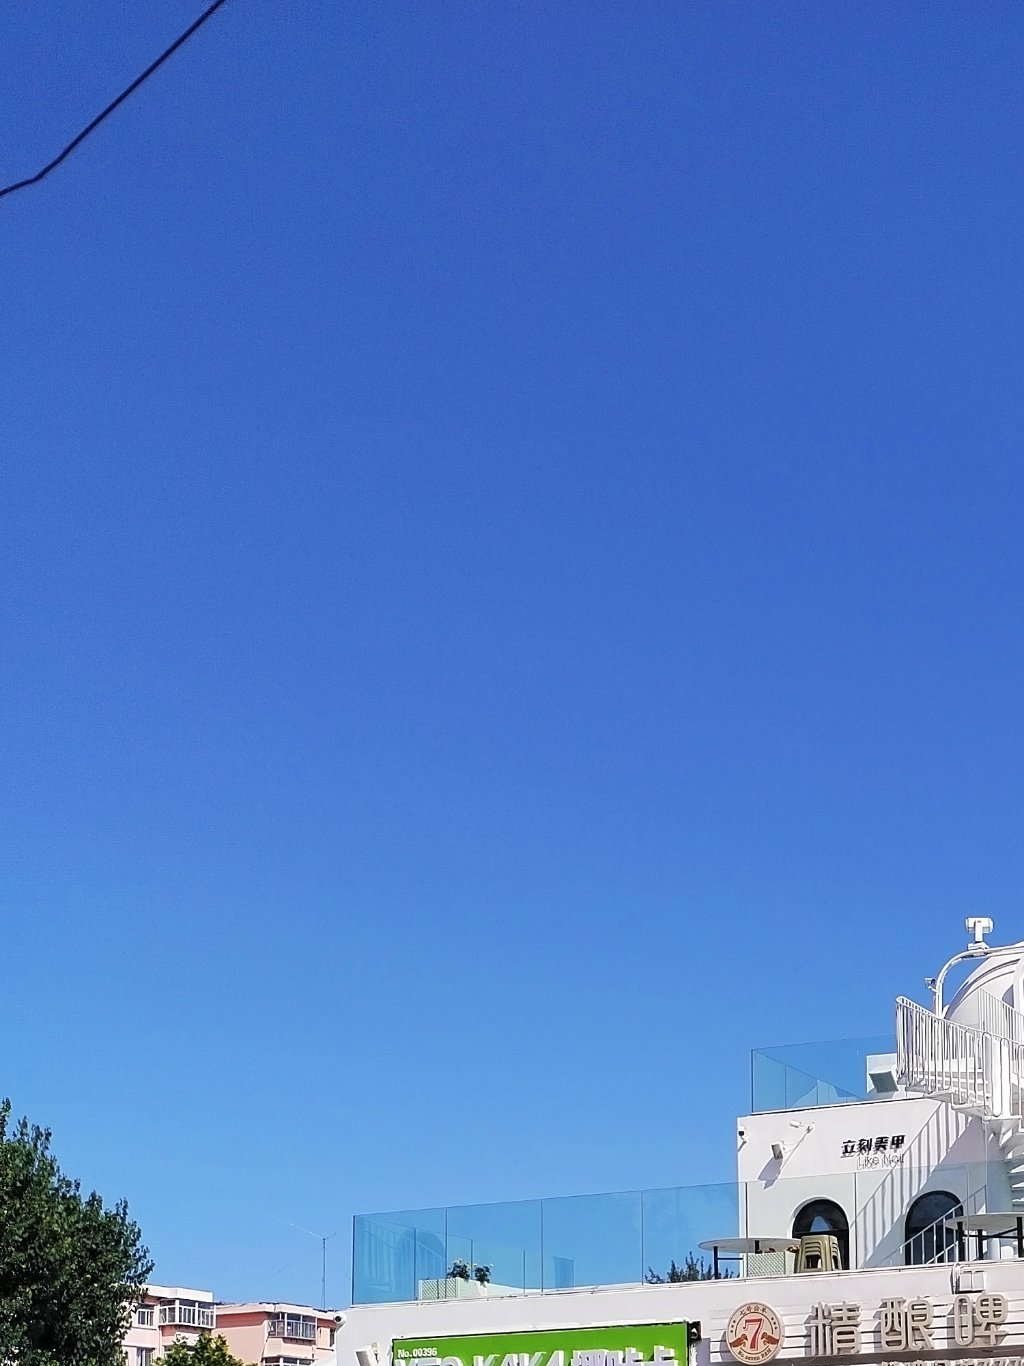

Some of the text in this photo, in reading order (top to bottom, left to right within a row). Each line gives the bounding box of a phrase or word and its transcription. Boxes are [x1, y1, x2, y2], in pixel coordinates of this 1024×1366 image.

[841, 1134, 906, 1157] 立刻美甲
[743, 1318, 764, 1351] 7
[397, 1347, 438, 1359] No.00396
